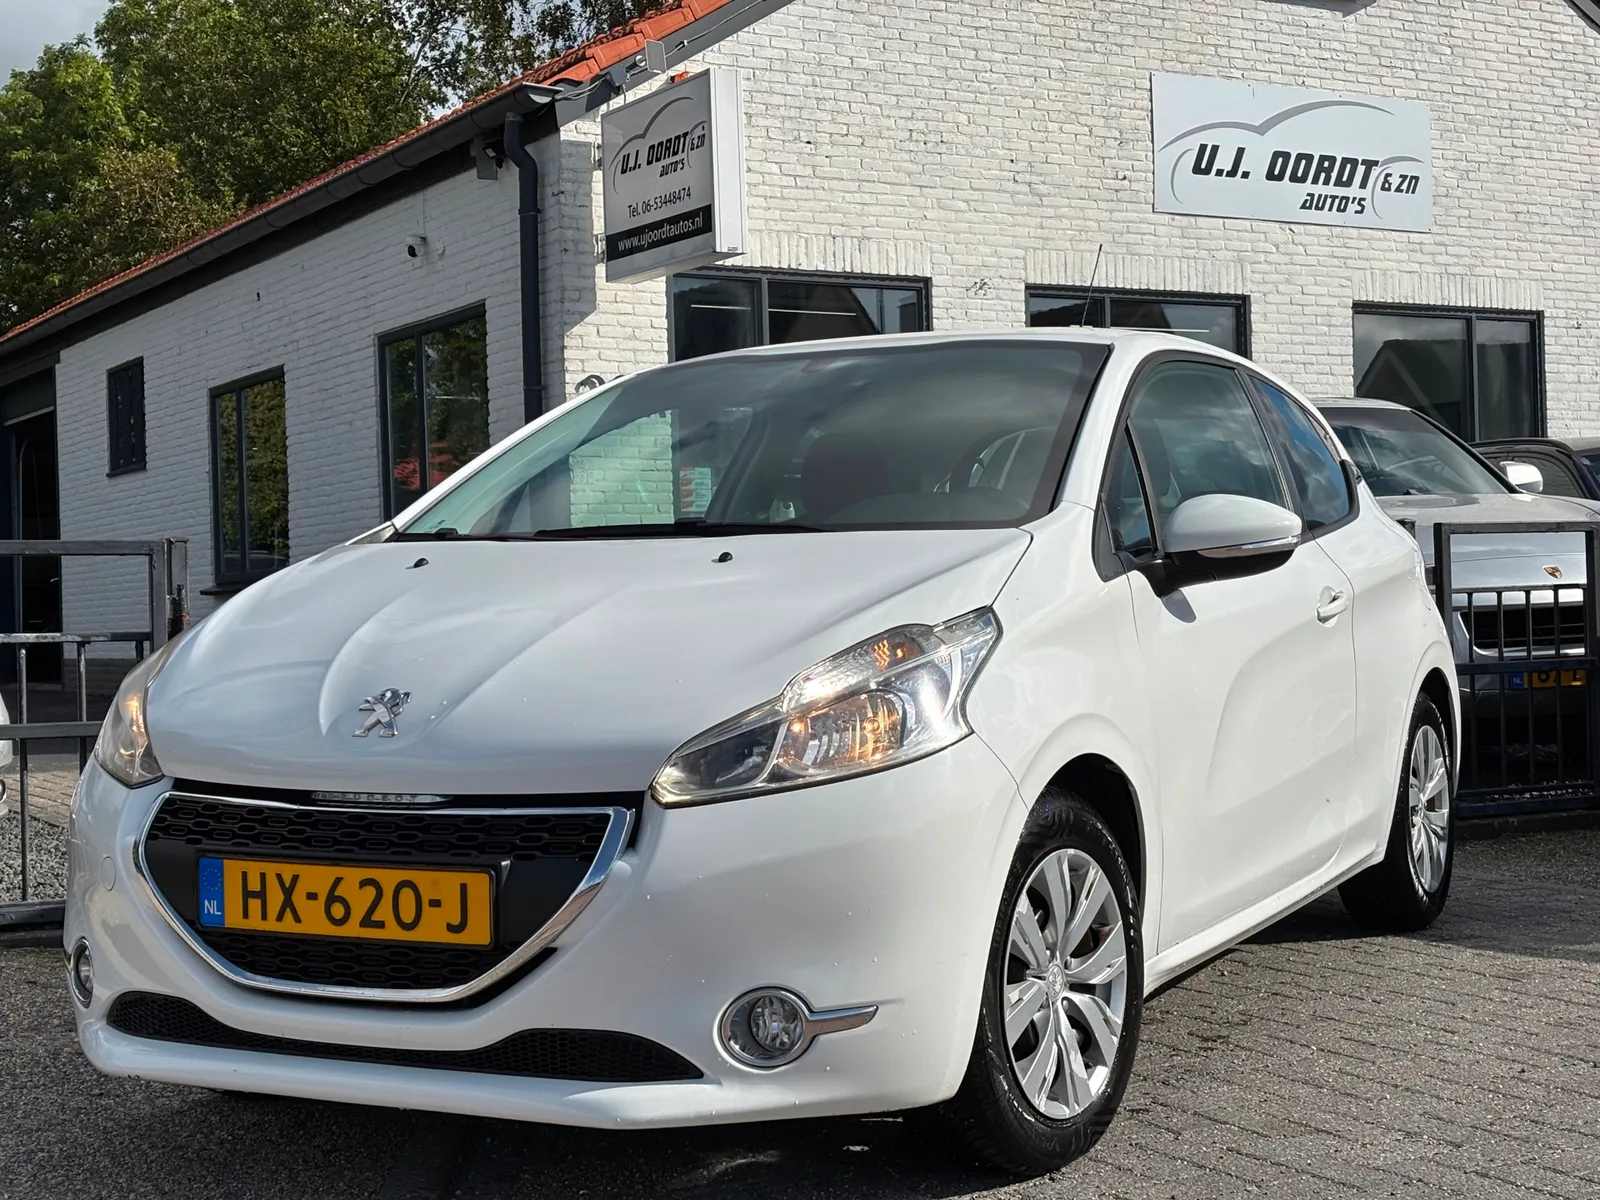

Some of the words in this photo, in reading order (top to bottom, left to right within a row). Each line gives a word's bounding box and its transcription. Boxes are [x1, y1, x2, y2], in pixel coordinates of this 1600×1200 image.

[620, 149, 642, 175] U.J.
[646, 131, 690, 166] OORDT
[1191, 143, 1251, 179] U.J.
[1265, 150, 1380, 190] OORDT
[627, 202, 641, 218] Tel.
[641, 186, 691, 214] 06-53448474
[1299, 192, 1367, 215] AUTO'S
[618, 211, 703, 252] www.ujoordtautos.nl
[204, 899, 222, 916] NL
[241, 870, 468, 934] HX-620-J
